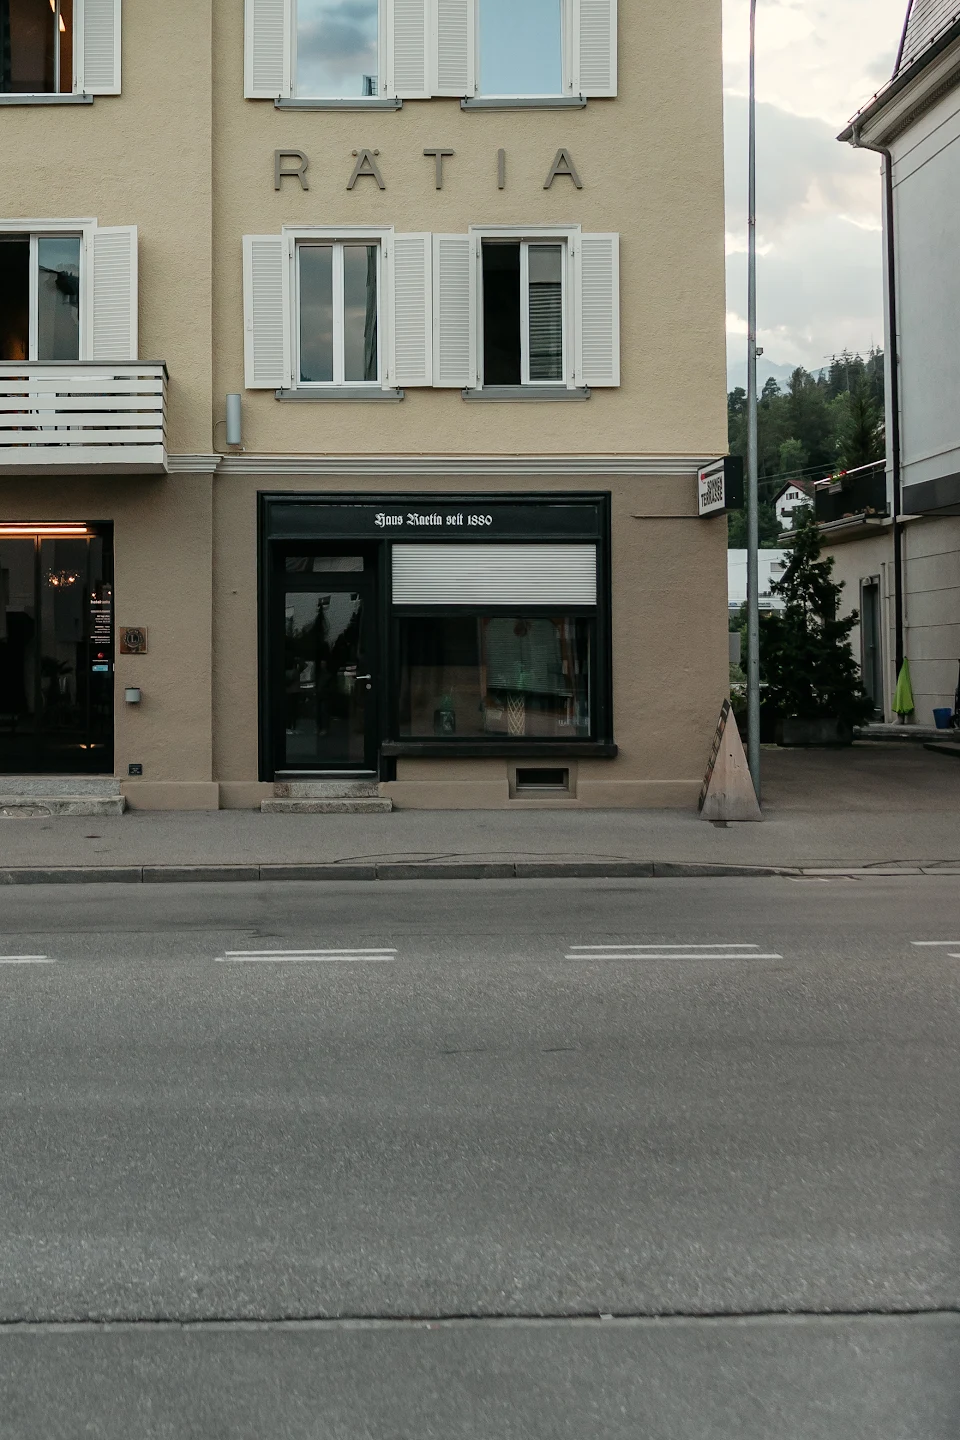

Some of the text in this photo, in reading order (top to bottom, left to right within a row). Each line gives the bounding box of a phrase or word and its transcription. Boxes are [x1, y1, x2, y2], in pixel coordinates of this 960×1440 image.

[274, 148, 583, 190] RÄTIA
[707, 476, 723, 492] SONNEN
[701, 487, 723, 507] TERRASSE
[374, 512, 403, 528] Haus
[445, 513, 464, 526] seit
[467, 514, 493, 526] 1880
